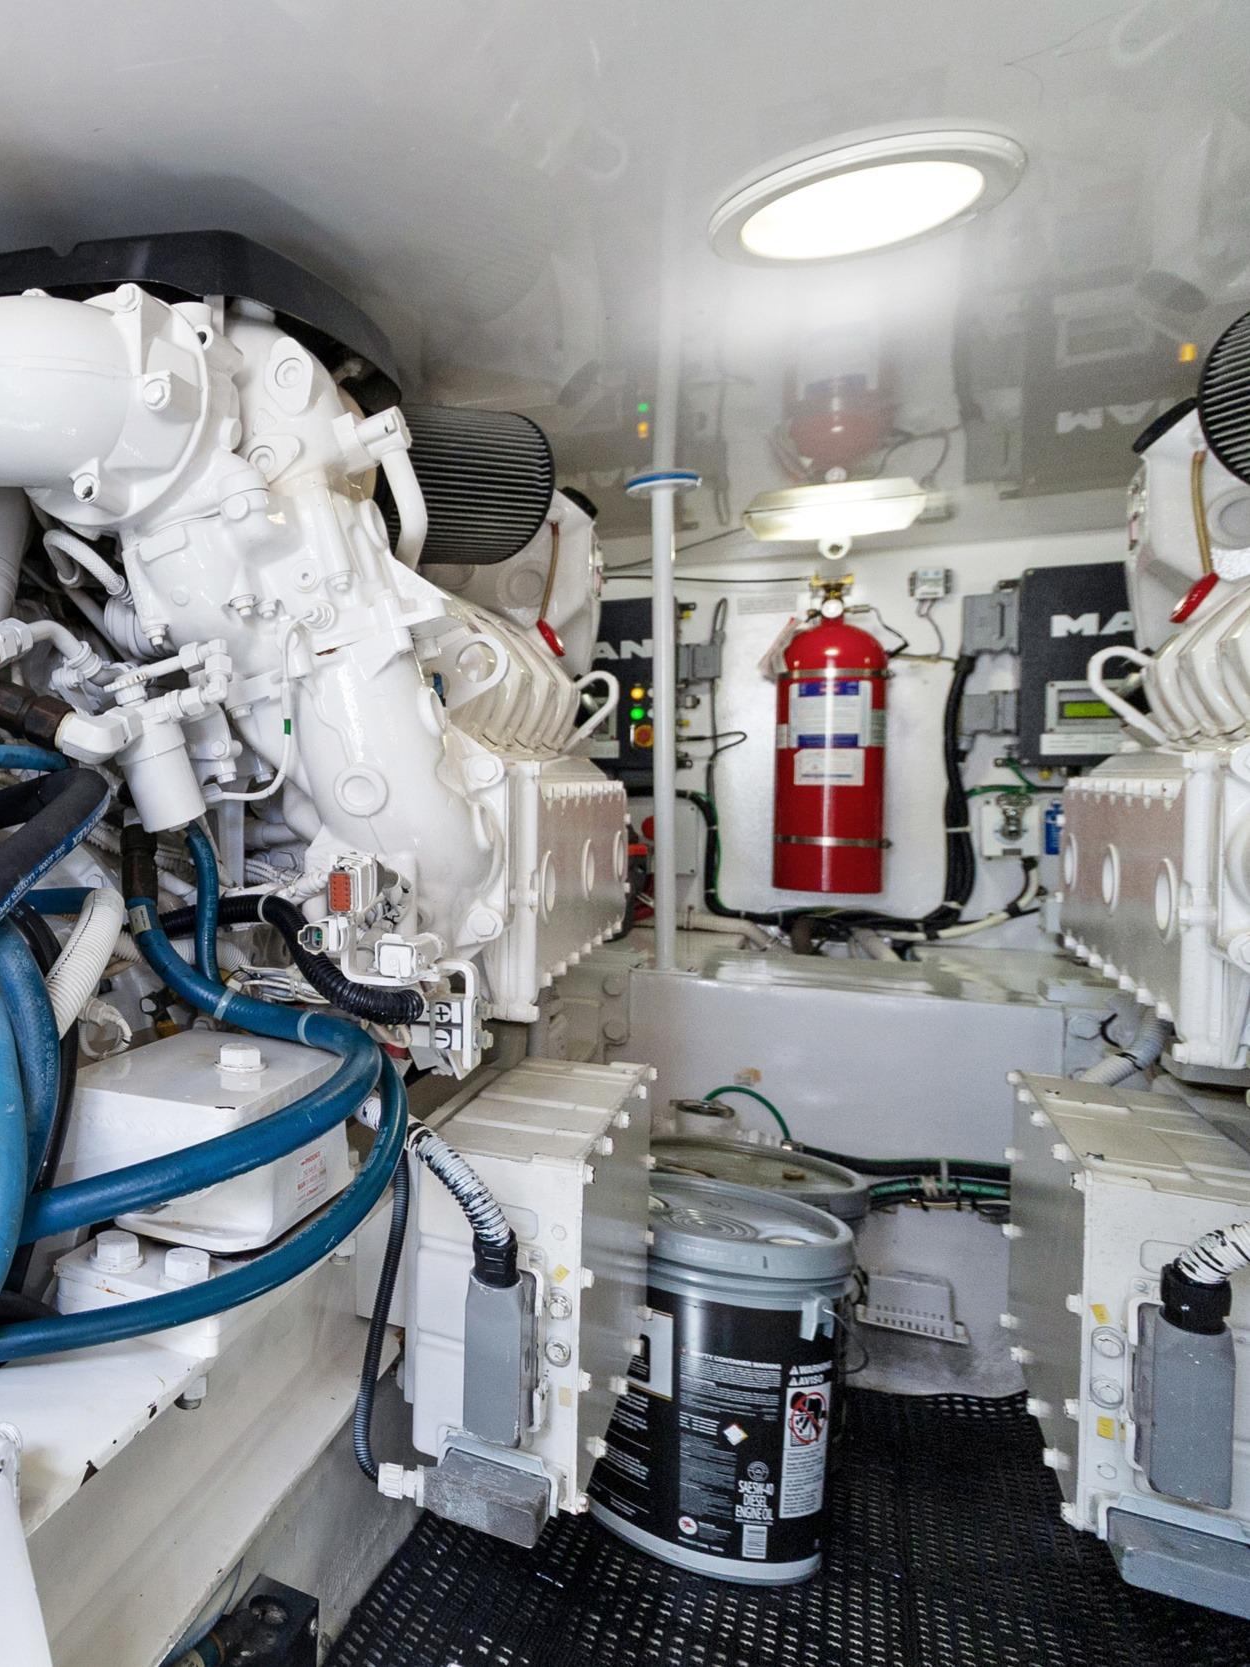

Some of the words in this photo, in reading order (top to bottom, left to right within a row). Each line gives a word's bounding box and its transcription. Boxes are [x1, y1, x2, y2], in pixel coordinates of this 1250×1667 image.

[1051, 611, 1134, 637] MA
[593, 638, 653, 660] AN
[798, 1374, 825, 1386] AVISO
[743, 1493, 768, 1508] DIESEL
